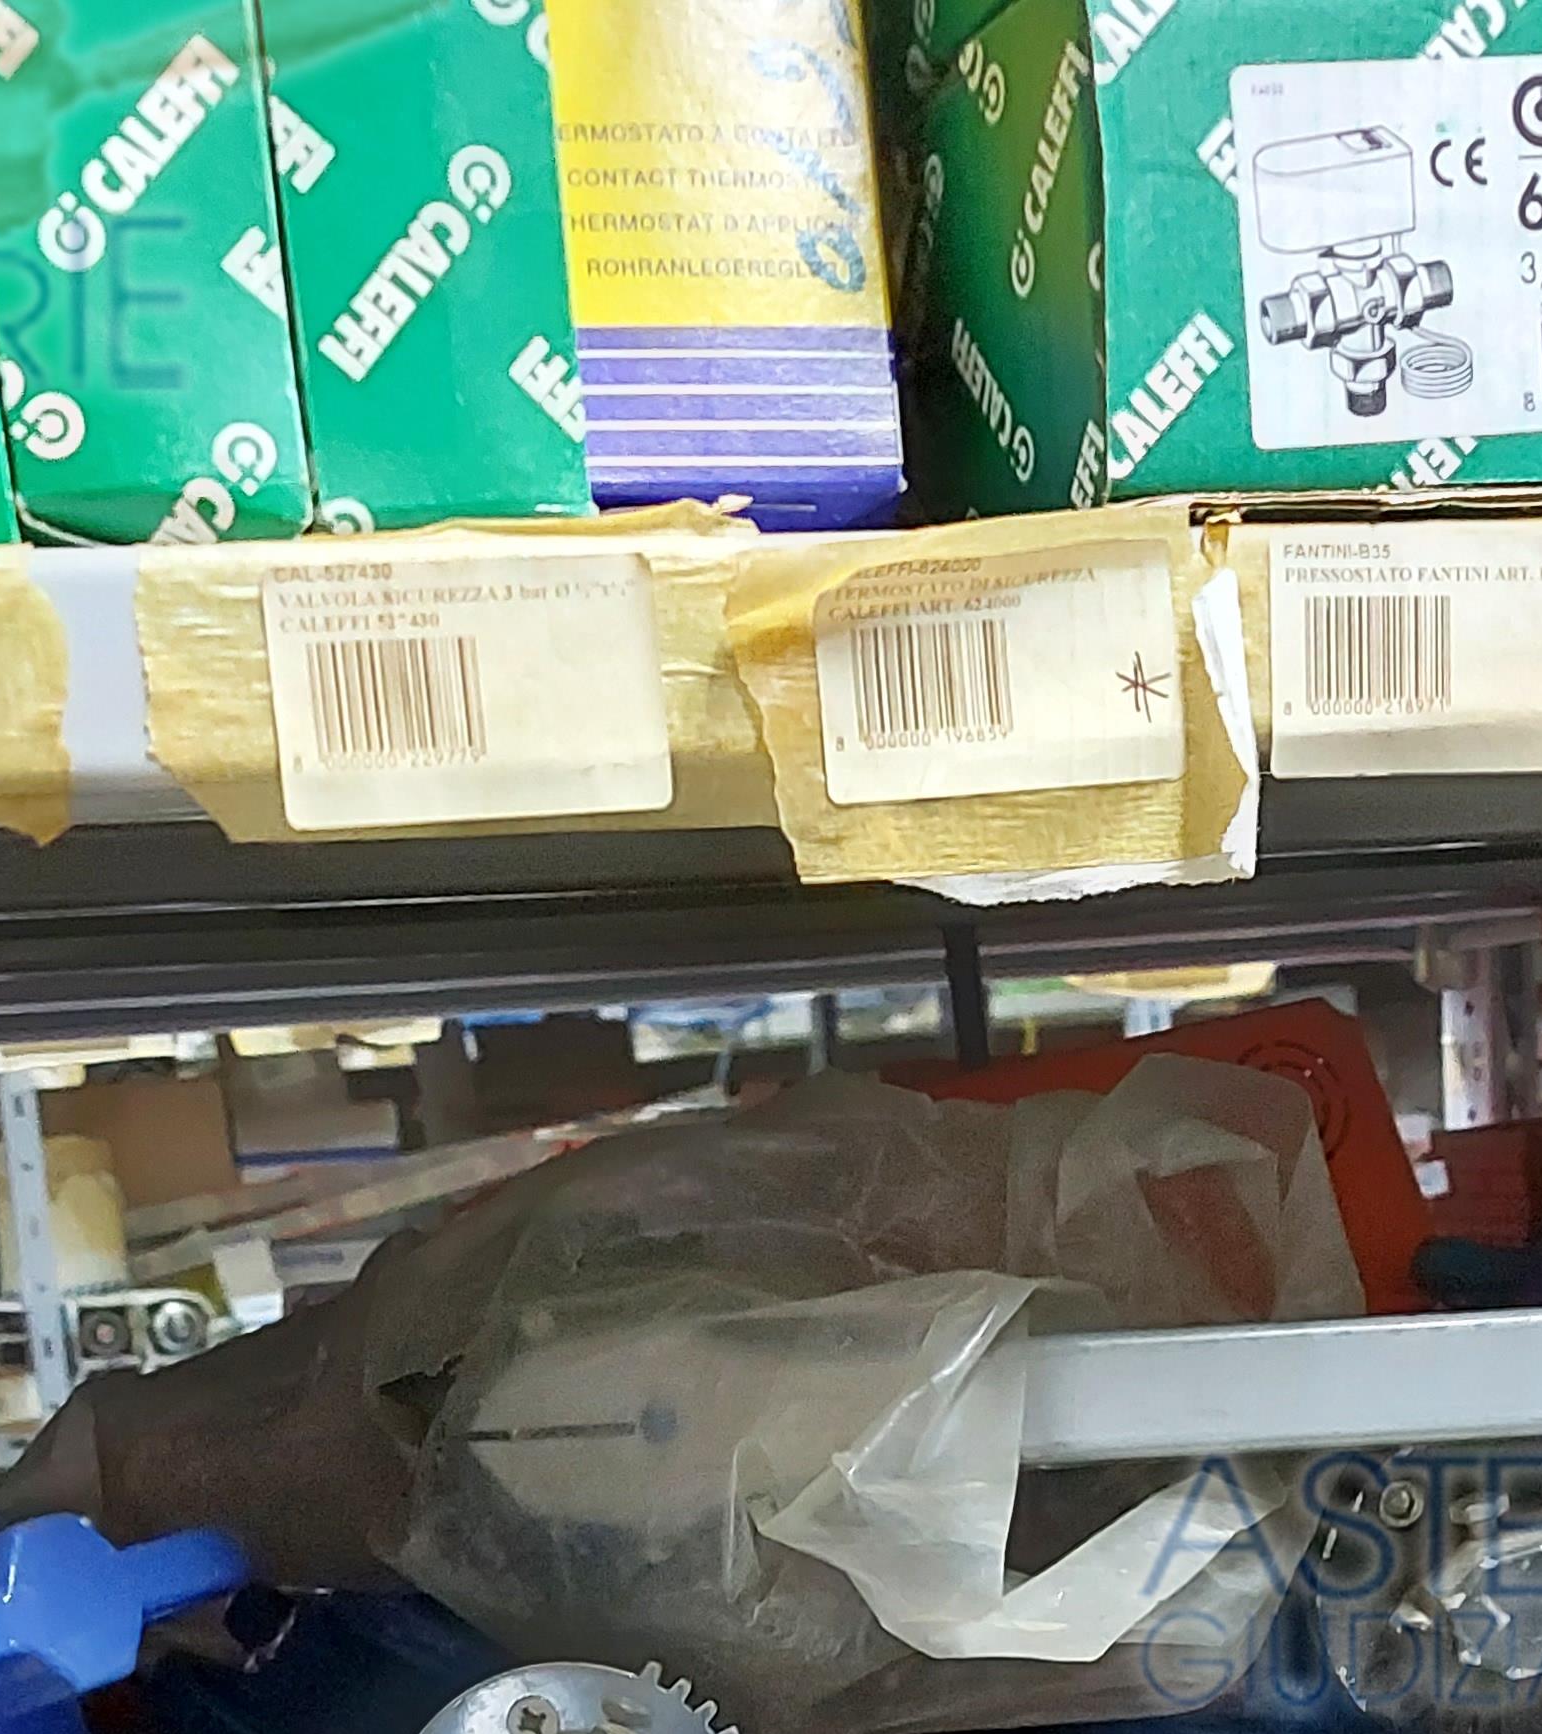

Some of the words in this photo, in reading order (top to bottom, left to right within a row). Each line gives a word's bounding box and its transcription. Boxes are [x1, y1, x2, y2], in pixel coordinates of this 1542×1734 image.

[81, 34, 241, 214] CALEFFI
[557, 123, 704, 144] ERMOSTATO
[1025, 41, 1091, 234] CALEFFI
[1430, 138, 1488, 187] CE
[569, 213, 713, 234] HERMOSTAT
[319, 200, 470, 382] CALEFFI
[1105, 310, 1235, 481] CALEFFI
[1523, 391, 1536, 412] 8
[1283, 543, 1391, 560] FANTINI-B35
[1284, 566, 1412, 583] PRESSOSTATO
[1417, 566, 1489, 582] FANTINI
[277, 590, 382, 610] VALVOLA
